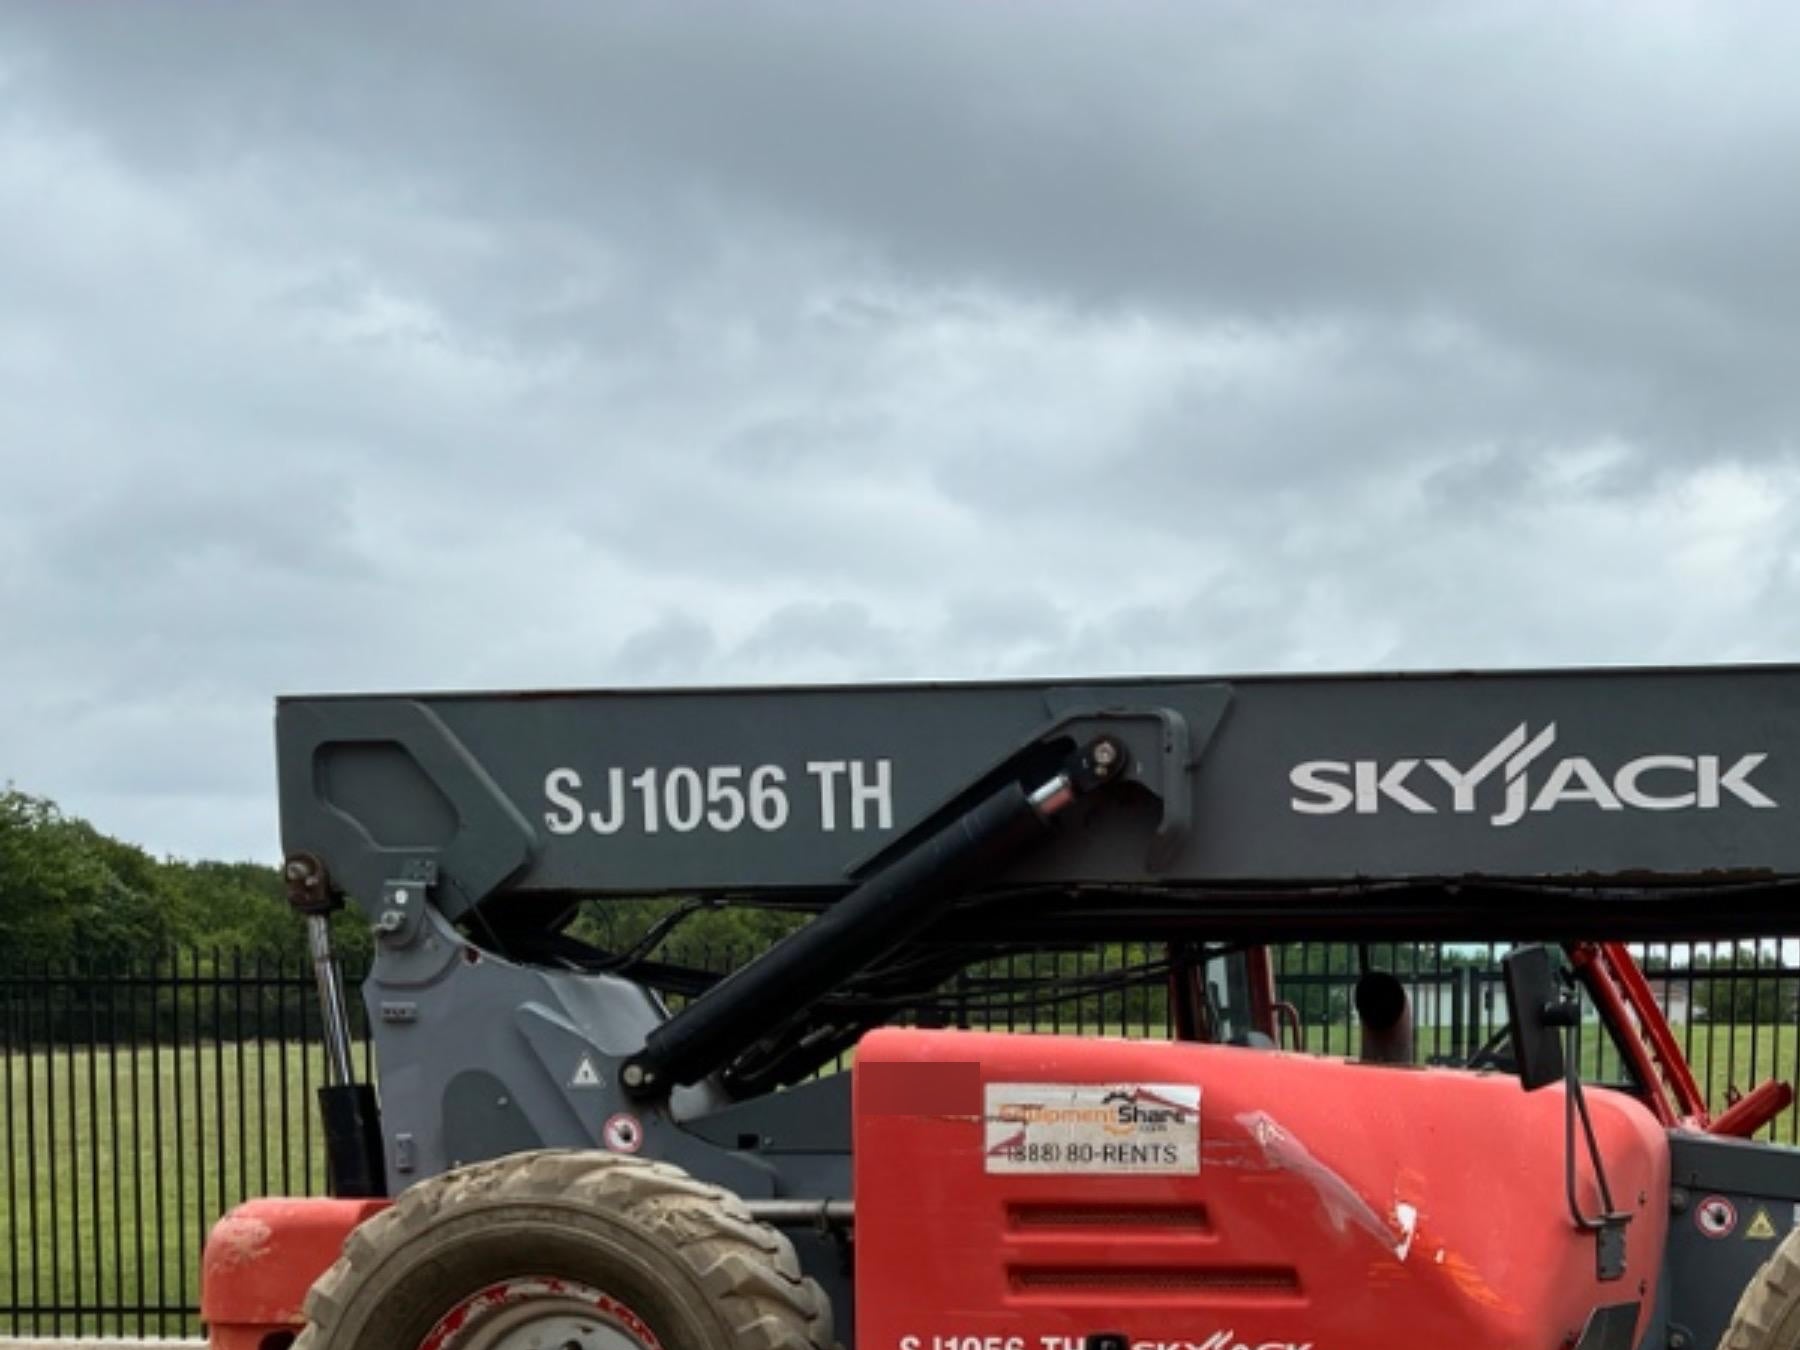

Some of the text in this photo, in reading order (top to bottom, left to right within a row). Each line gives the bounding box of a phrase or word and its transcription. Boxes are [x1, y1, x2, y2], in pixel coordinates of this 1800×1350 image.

[544, 759, 893, 835] SJ1056 TH
[1289, 721, 1778, 827] SKYJACK
[1066, 1143, 1177, 1164] 80-RENTS
